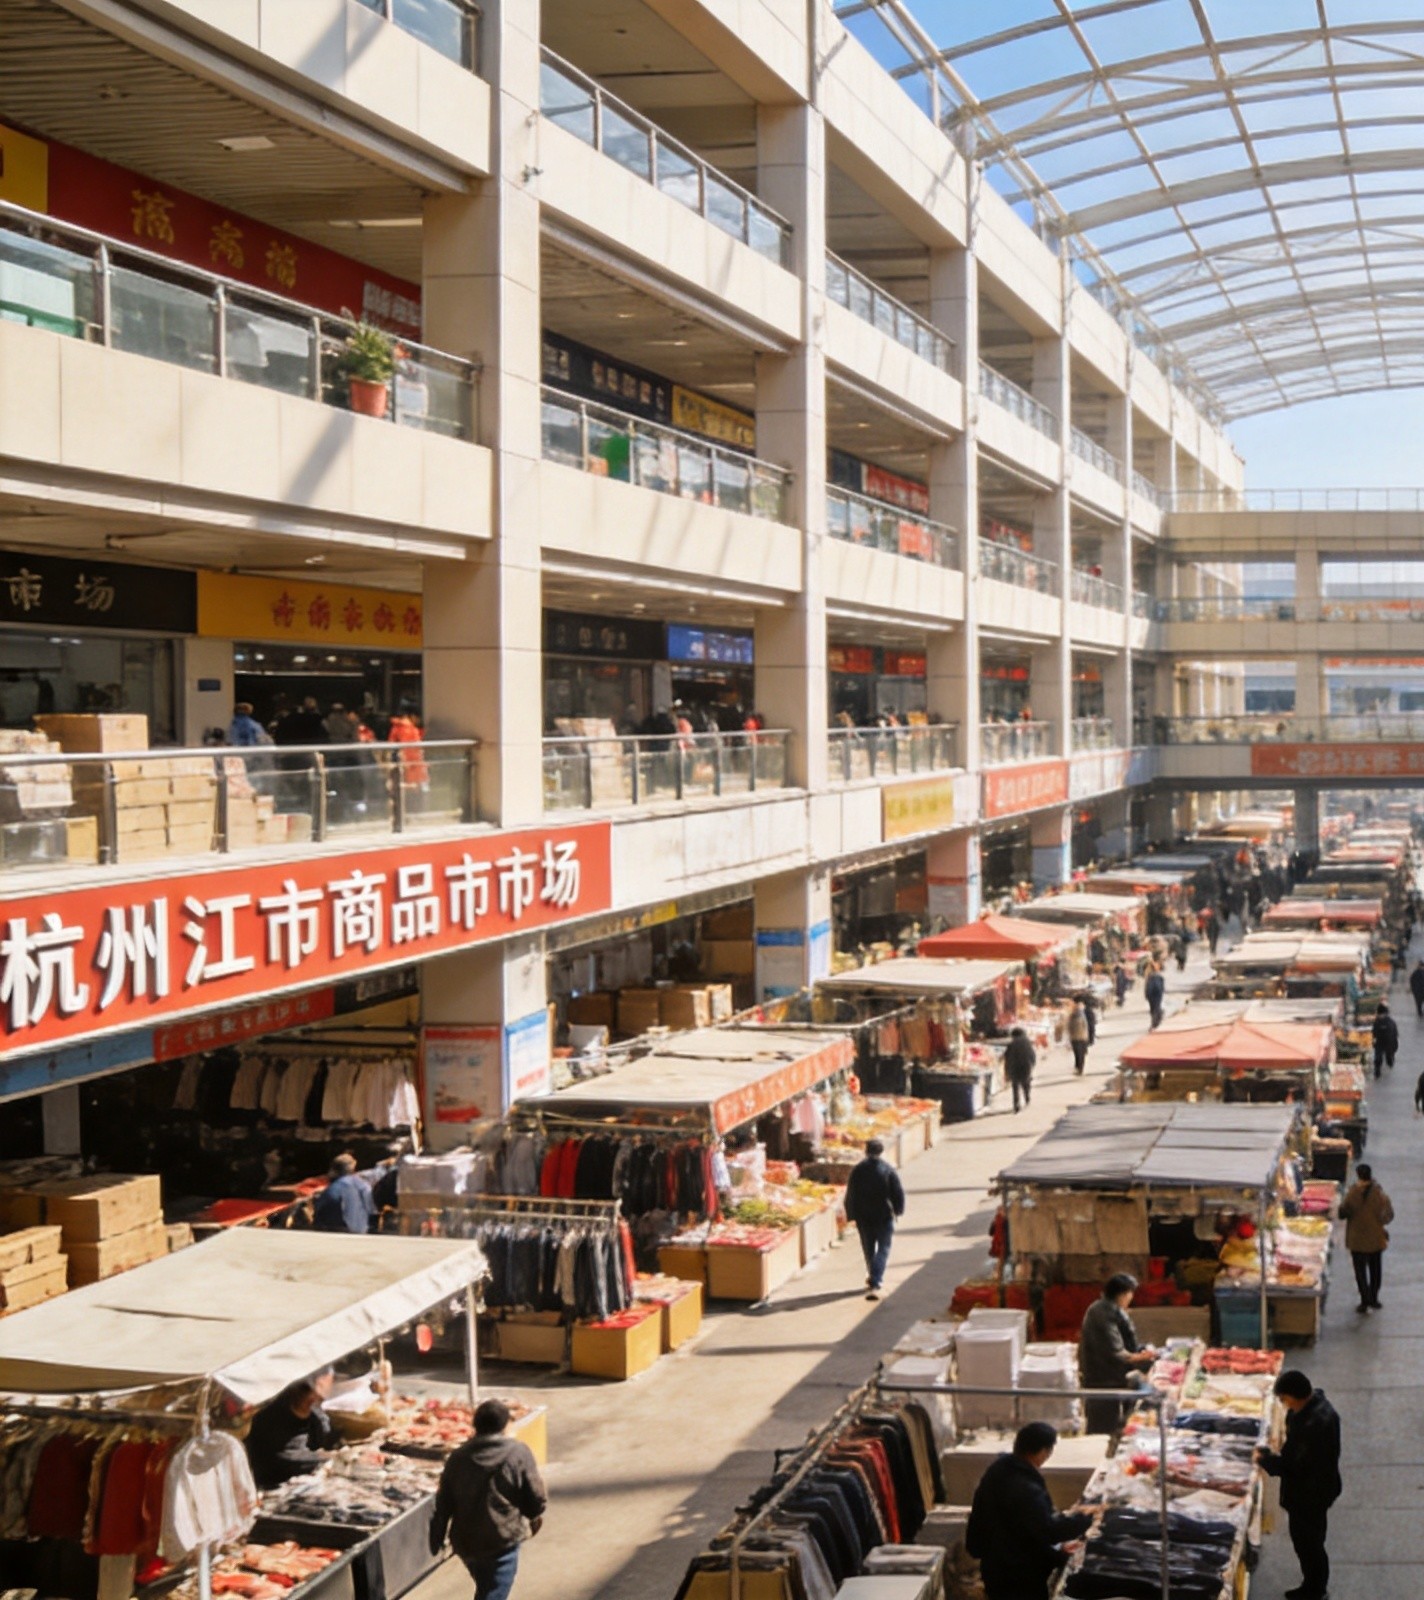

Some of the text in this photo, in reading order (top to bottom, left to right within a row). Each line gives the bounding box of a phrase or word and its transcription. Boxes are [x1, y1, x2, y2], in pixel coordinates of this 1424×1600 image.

[0, 839, 581, 1029] 杭州江市商品市市场
